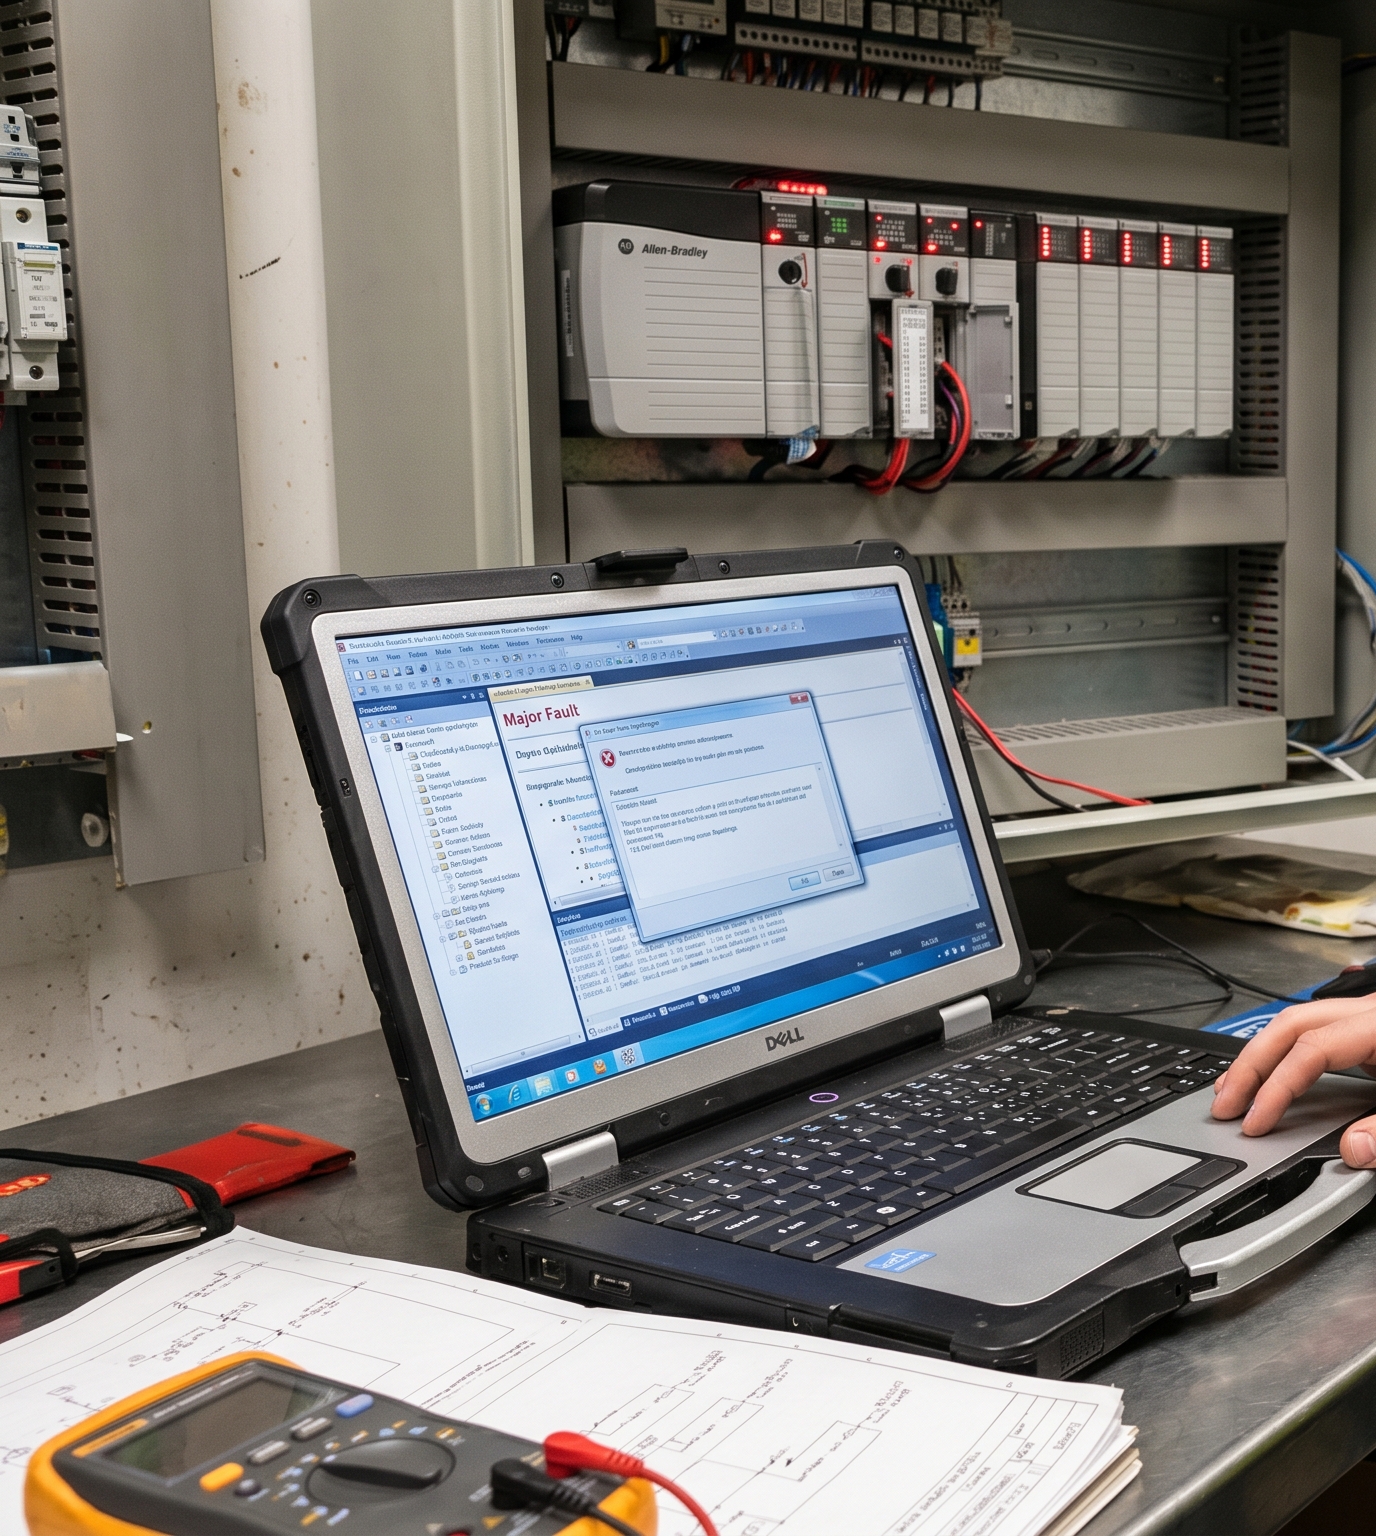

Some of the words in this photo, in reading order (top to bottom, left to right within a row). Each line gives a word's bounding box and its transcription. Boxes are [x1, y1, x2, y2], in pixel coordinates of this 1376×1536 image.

[642, 243, 708, 259] Allen-Bradley
[502, 710, 542, 728] Major
[544, 703, 581, 721] Fault
[764, 1027, 805, 1052] DELL
